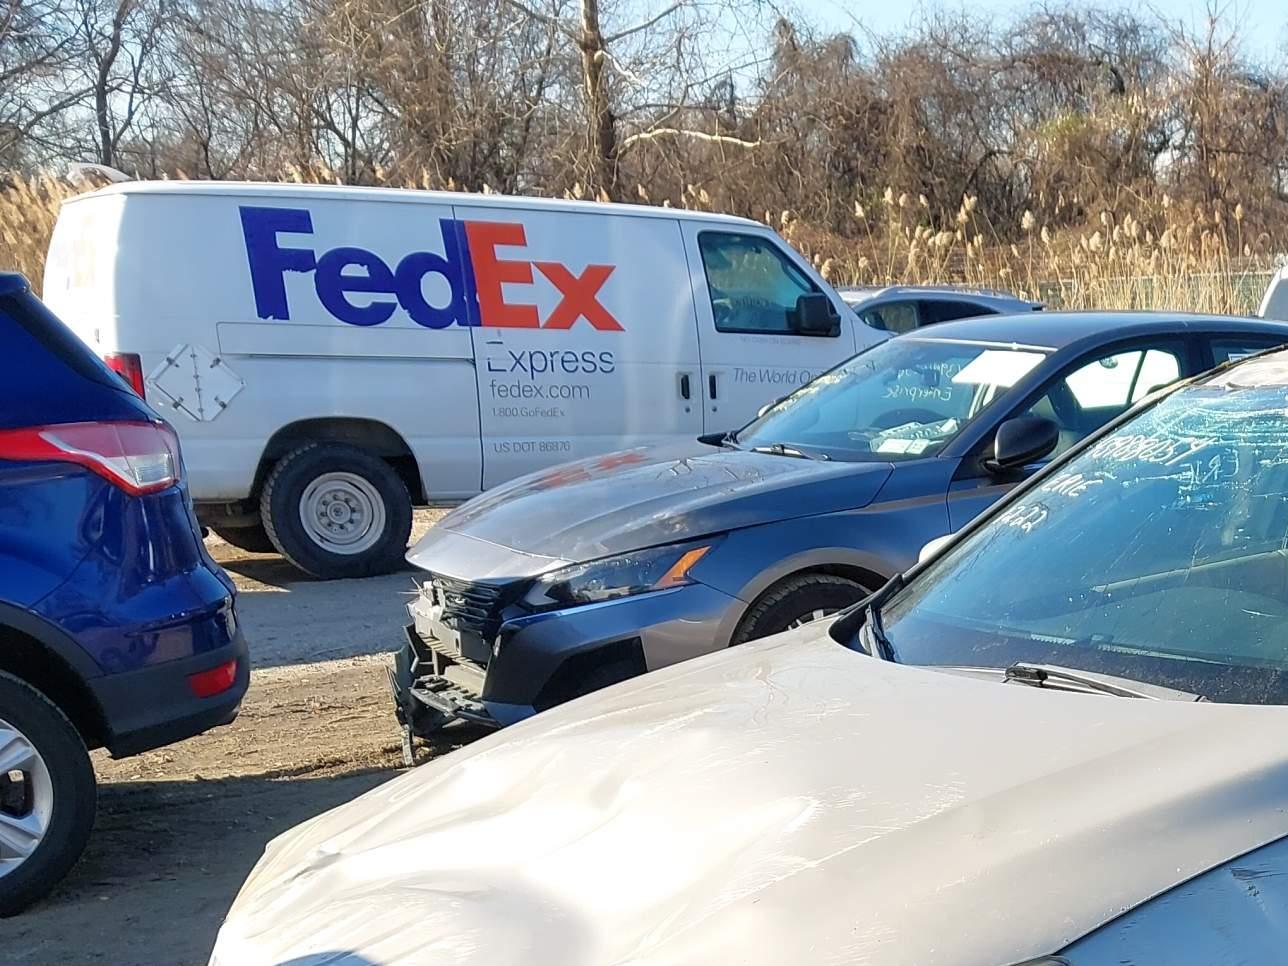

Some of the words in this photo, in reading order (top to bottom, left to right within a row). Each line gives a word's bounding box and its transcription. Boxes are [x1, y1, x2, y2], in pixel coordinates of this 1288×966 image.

[238, 205, 626, 332] FedEx
[486, 341, 616, 380] Express
[733, 367, 757, 383] The
[759, 368, 797, 384] World
[489, 379, 591, 399] fedex.com
[494, 441, 511, 453] US
[512, 441, 537, 453] DOT
